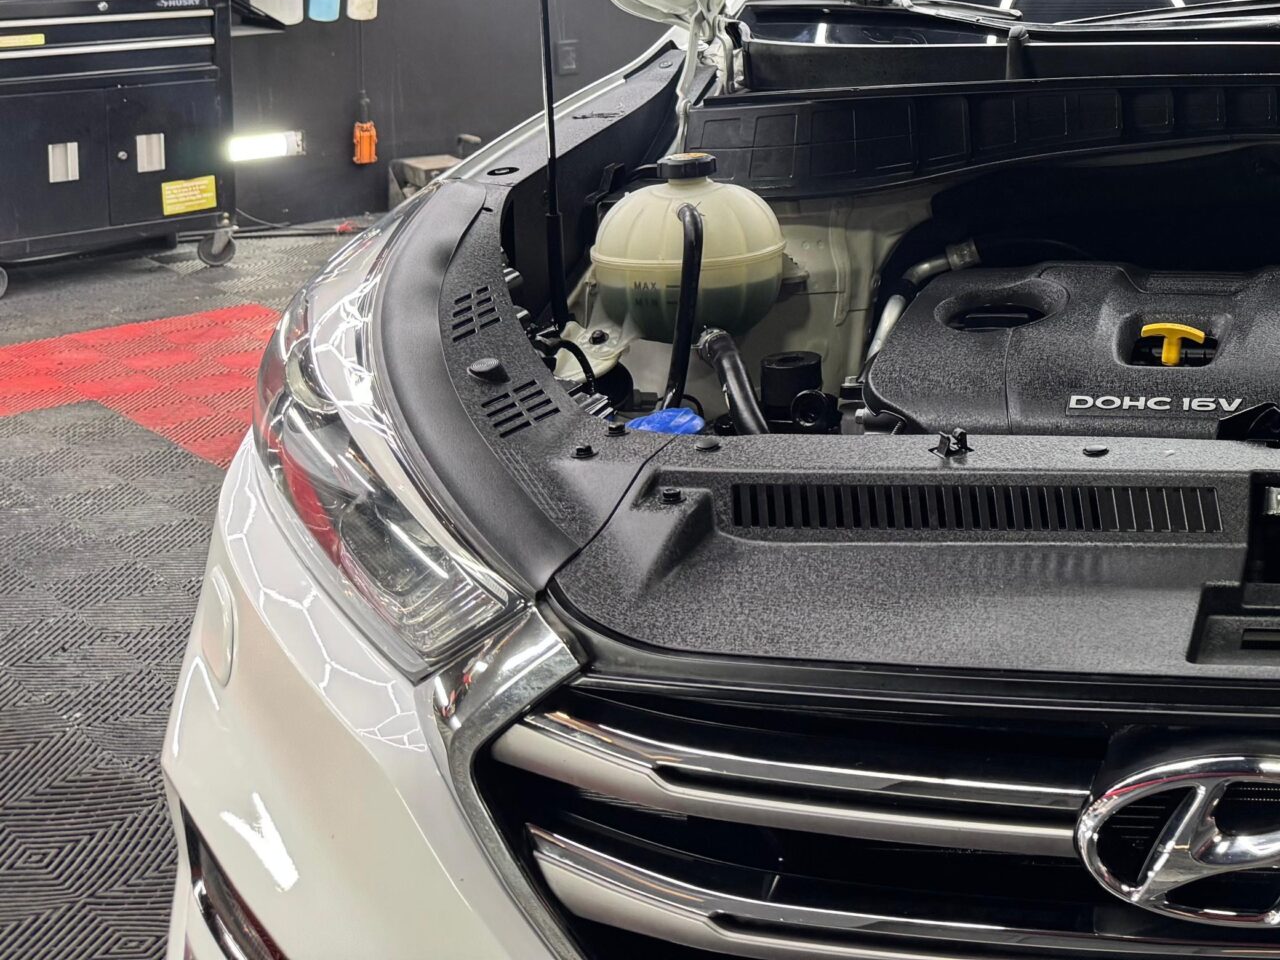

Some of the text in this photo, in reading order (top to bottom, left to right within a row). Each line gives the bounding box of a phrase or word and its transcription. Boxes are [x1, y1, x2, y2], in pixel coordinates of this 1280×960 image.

[633, 280, 657, 290] MAX
[1069, 395, 1243, 412] DOHC 16V
